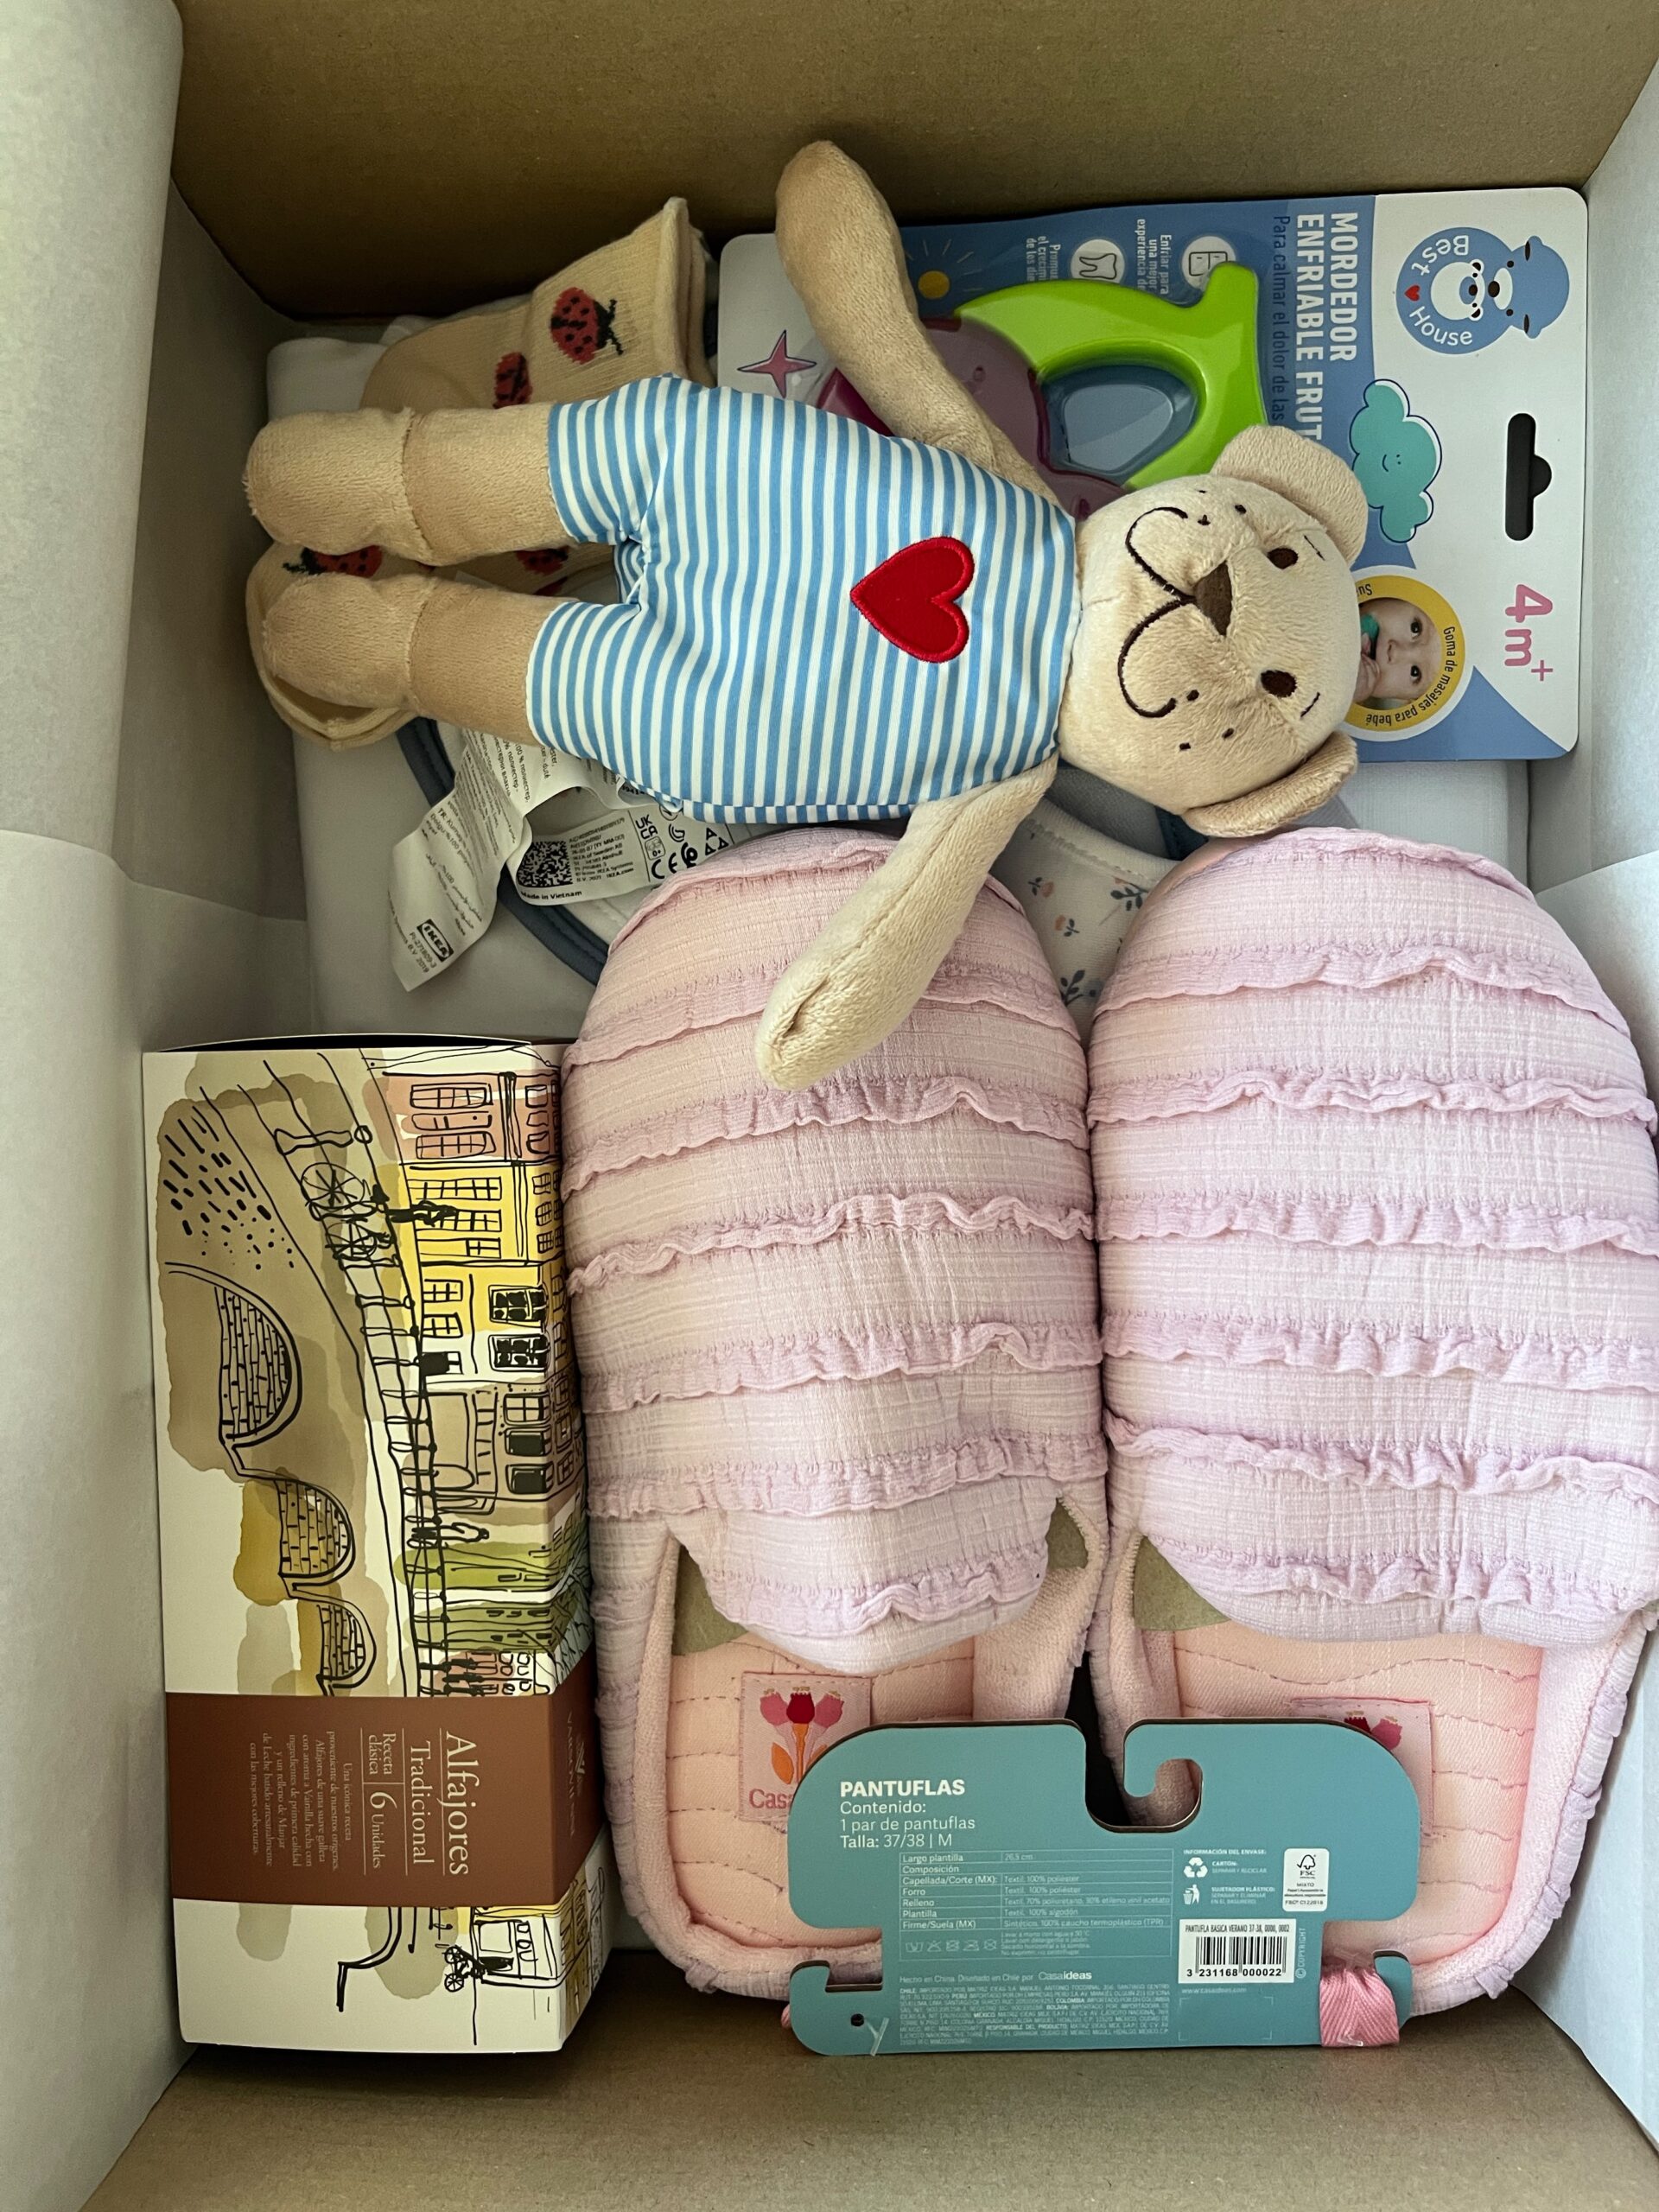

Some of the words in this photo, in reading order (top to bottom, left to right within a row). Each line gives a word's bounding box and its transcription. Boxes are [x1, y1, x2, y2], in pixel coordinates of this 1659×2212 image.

[1027, 238, 1036, 248] de
[1273, 215, 1291, 249] Para
[1027, 251, 1036, 264] los
[1135, 219, 1147, 276] experiencia
[1148, 239, 1157, 257] una
[1160, 235, 1172, 269] Enfriar
[1411, 235, 1469, 276] Best
[1146, 261, 1158, 289] mejor
[1158, 272, 1169, 295] para
[1273, 255, 1291, 306] calmar
[1296, 214, 1324, 361] ENFRIABLE
[1330, 213, 1358, 361] MORDEDOR
[1273, 313, 1290, 325] el
[1409, 306, 1473, 346] House
[1273, 333, 1290, 369] dolor
[1273, 377, 1289, 393] de
[1272, 400, 1288, 421] las
[1444, 626, 1456, 657] Goma
[1445, 659, 1458, 672] de
[1419, 675, 1451, 711] masajes
[1366, 714, 1391, 726] bebé
[1395, 705, 1417, 722] para
[635, 815, 652, 829] UK
[550, 891, 582, 899] Vietnam
[424, 925, 448, 958] IKEA
[263, 1733, 271, 1744] de
[251, 1761, 259, 1771] las
[263, 1746, 273, 1770] Leche
[276, 1759, 283, 1770] un
[287, 1735, 298, 1785] ingredientes
[315, 1739, 325, 1777] Alfajores
[327, 1731, 337, 1782] proveniente
[368, 1734, 381, 1775] clásica
[382, 1733, 396, 1775] Receta
[317, 1779, 326, 1790] de
[343, 1763, 353, 1782] Una
[249, 1774, 258, 1807] mejores
[264, 1773, 273, 1801] batido
[276, 1773, 286, 1802] relleno
[290, 1788, 299, 1798] de
[330, 1783, 340, 1794] de
[344, 1784, 353, 1814] icónica
[370, 1791, 397, 1809] 6
[840, 1779, 965, 1797] PANTUFLAS
[278, 1804, 287, 1815] de
[304, 1789, 313, 1821] Vainilla
[410, 1741, 435, 1864] Tradicional
[436, 1731, 480, 1875] Alfajores
[840, 1800, 926, 1815] Contenido:
[289, 1801, 299, 1834] primera
[841, 1819, 846, 1831] 1
[852, 1821, 876, 1834] par
[880, 1817, 899, 1830] de
[905, 1815, 976, 1833] pantuflas
[264, 1802, 275, 1866] artesanalmente
[276, 1818, 287, 1849] Manjar
[305, 1824, 314, 1848] hecha
[372, 1815, 385, 1869] Unidades
[840, 1835, 879, 1848] Talla:
[884, 1834, 925, 1847] 37/38
[938, 1834, 952, 1847] M
[292, 1836, 302, 1866] calidad
[316, 1835, 327, 1862] galleta
[903, 1854, 927, 1864] Largo
[930, 1853, 963, 1864] plantilla
[903, 1866, 959, 1875] Composición
[903, 1876, 973, 1886] Capellada/Corte
[903, 1920, 953, 1929] Firme/Suela
[956, 1920, 976, 1929] (MX)
[1298, 1929, 1306, 1967] COPYRIGHT
